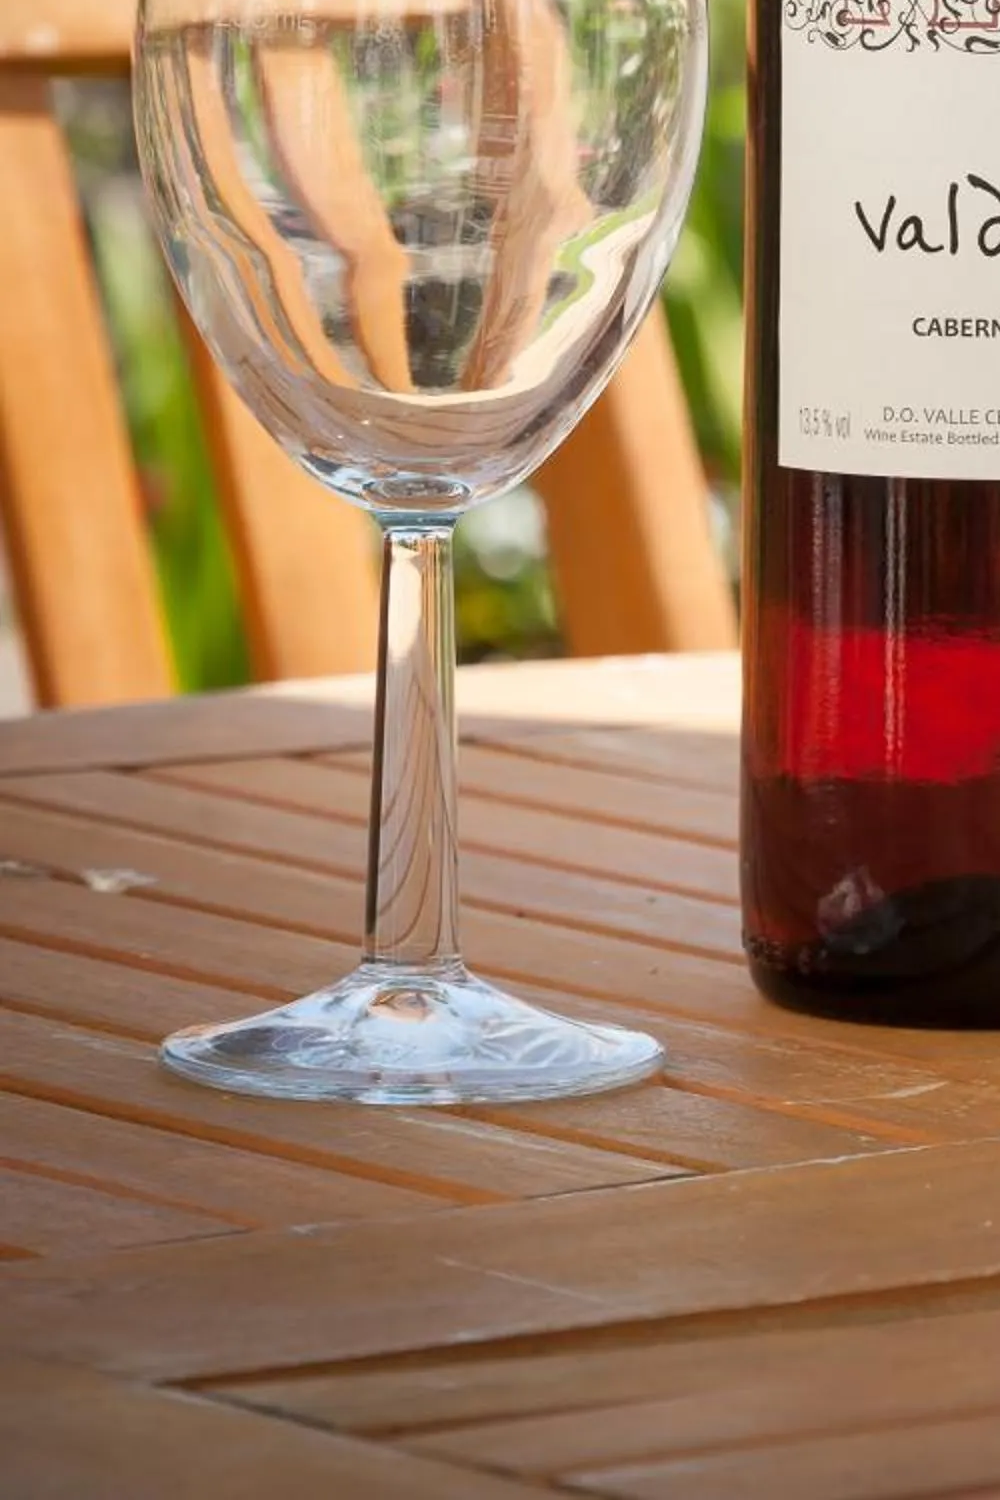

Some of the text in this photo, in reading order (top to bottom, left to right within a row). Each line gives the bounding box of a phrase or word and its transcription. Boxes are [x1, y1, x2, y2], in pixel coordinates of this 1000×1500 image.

[883, 407, 919, 423] D.O.
[924, 408, 980, 425] VALLE
[864, 428, 897, 442] Wine
[900, 430, 943, 444] Estate
[947, 431, 999, 445] Bottled
